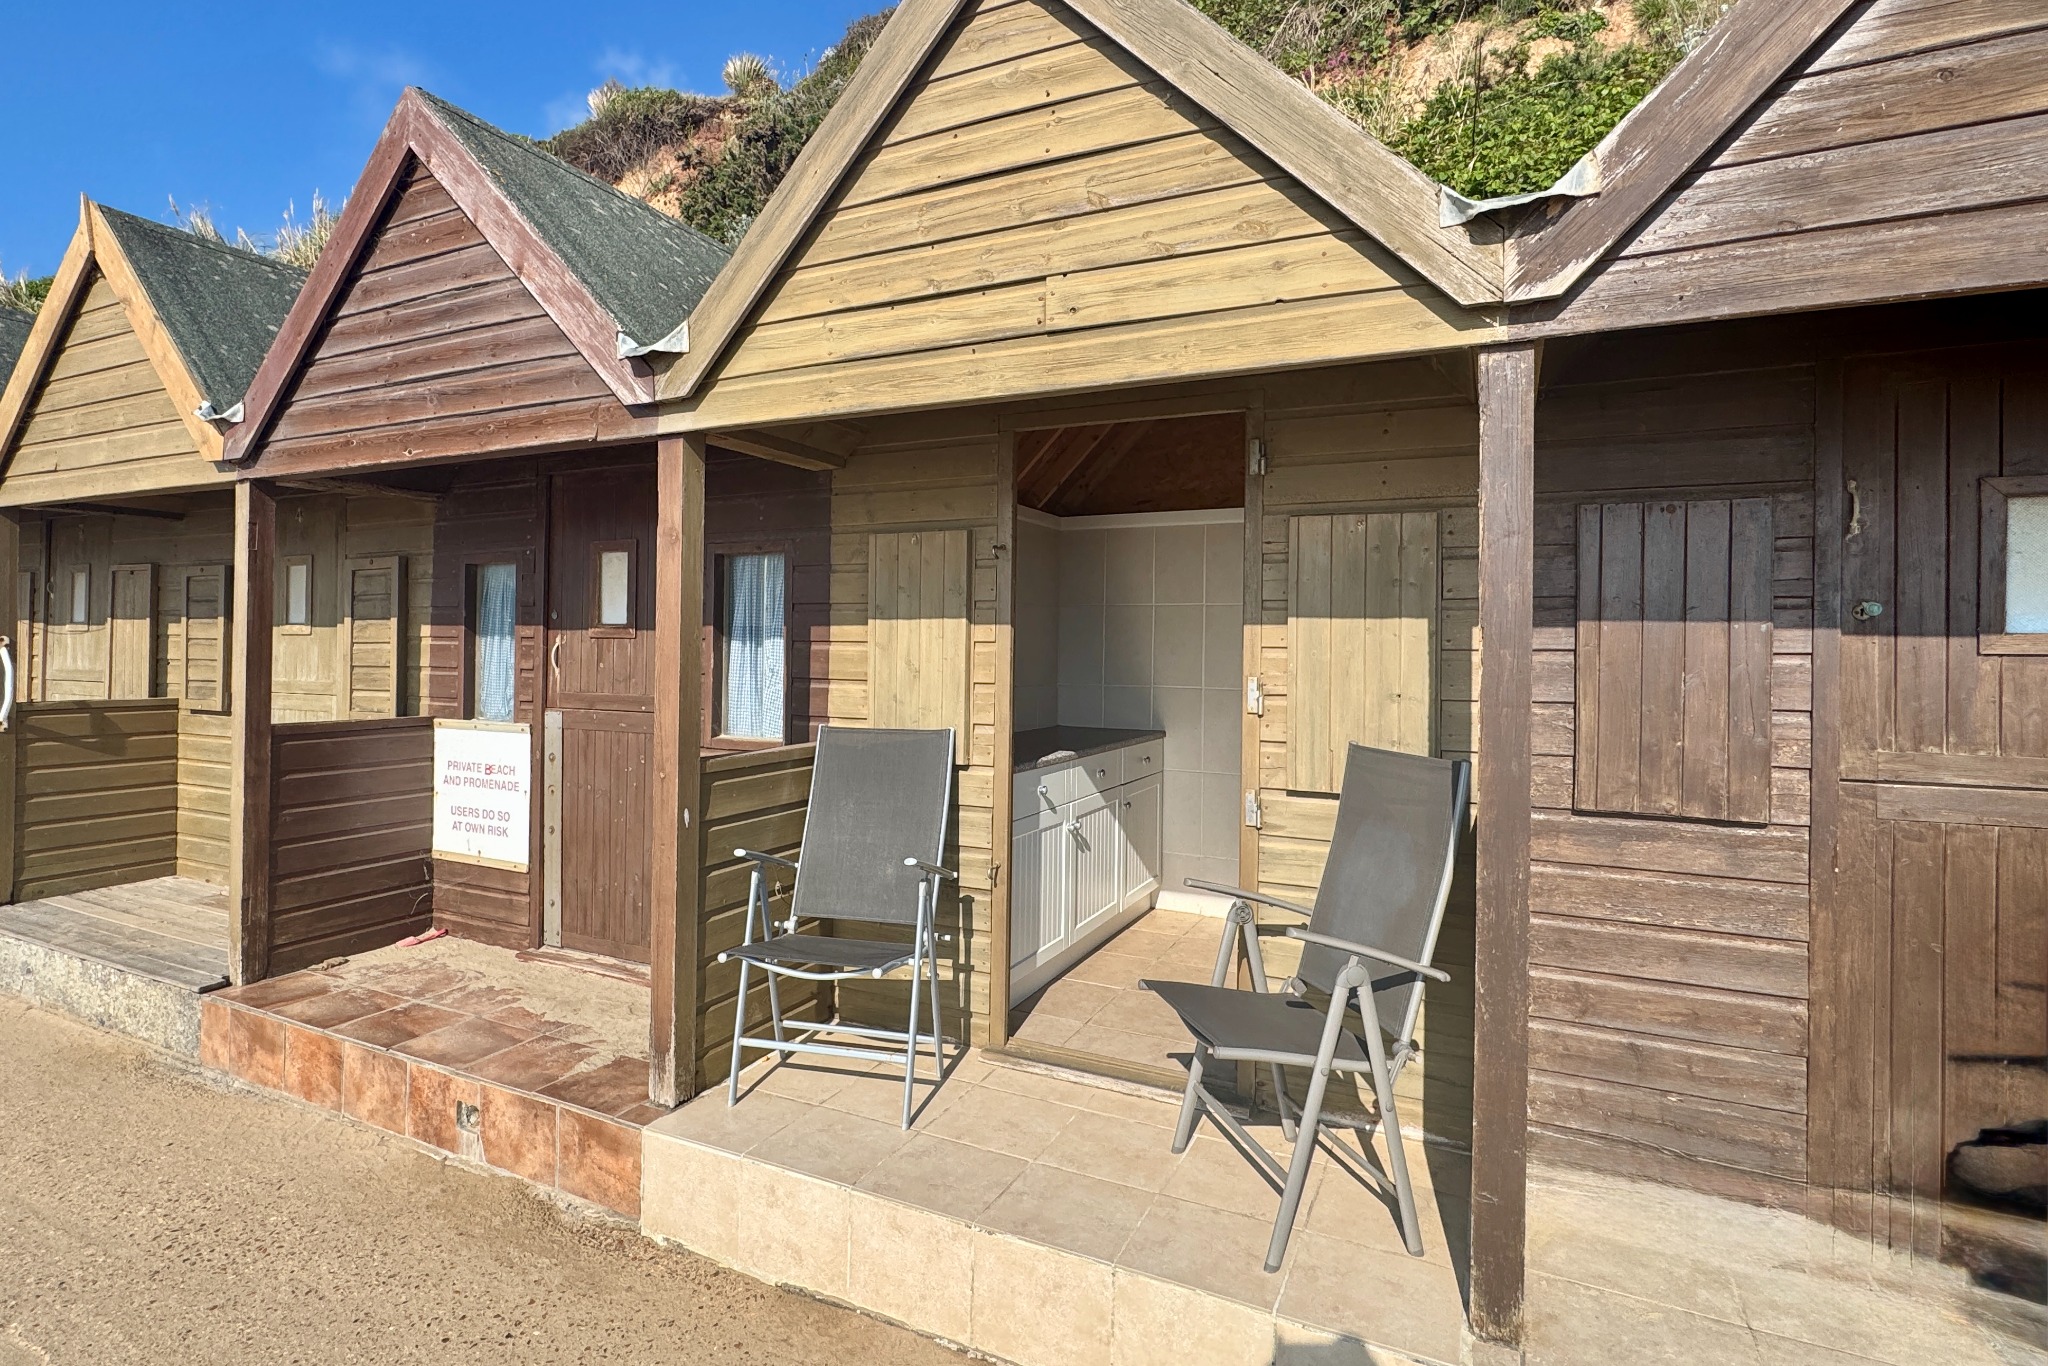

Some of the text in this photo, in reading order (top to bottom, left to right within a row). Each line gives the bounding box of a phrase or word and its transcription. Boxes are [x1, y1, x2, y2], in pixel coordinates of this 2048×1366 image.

[447, 760, 516, 776] PRIVATE BEACH
[443, 774, 520, 792] AND PROMENADE
[450, 805, 511, 822] USERS DO SO
[452, 820, 509, 838] AT OWN RISK
